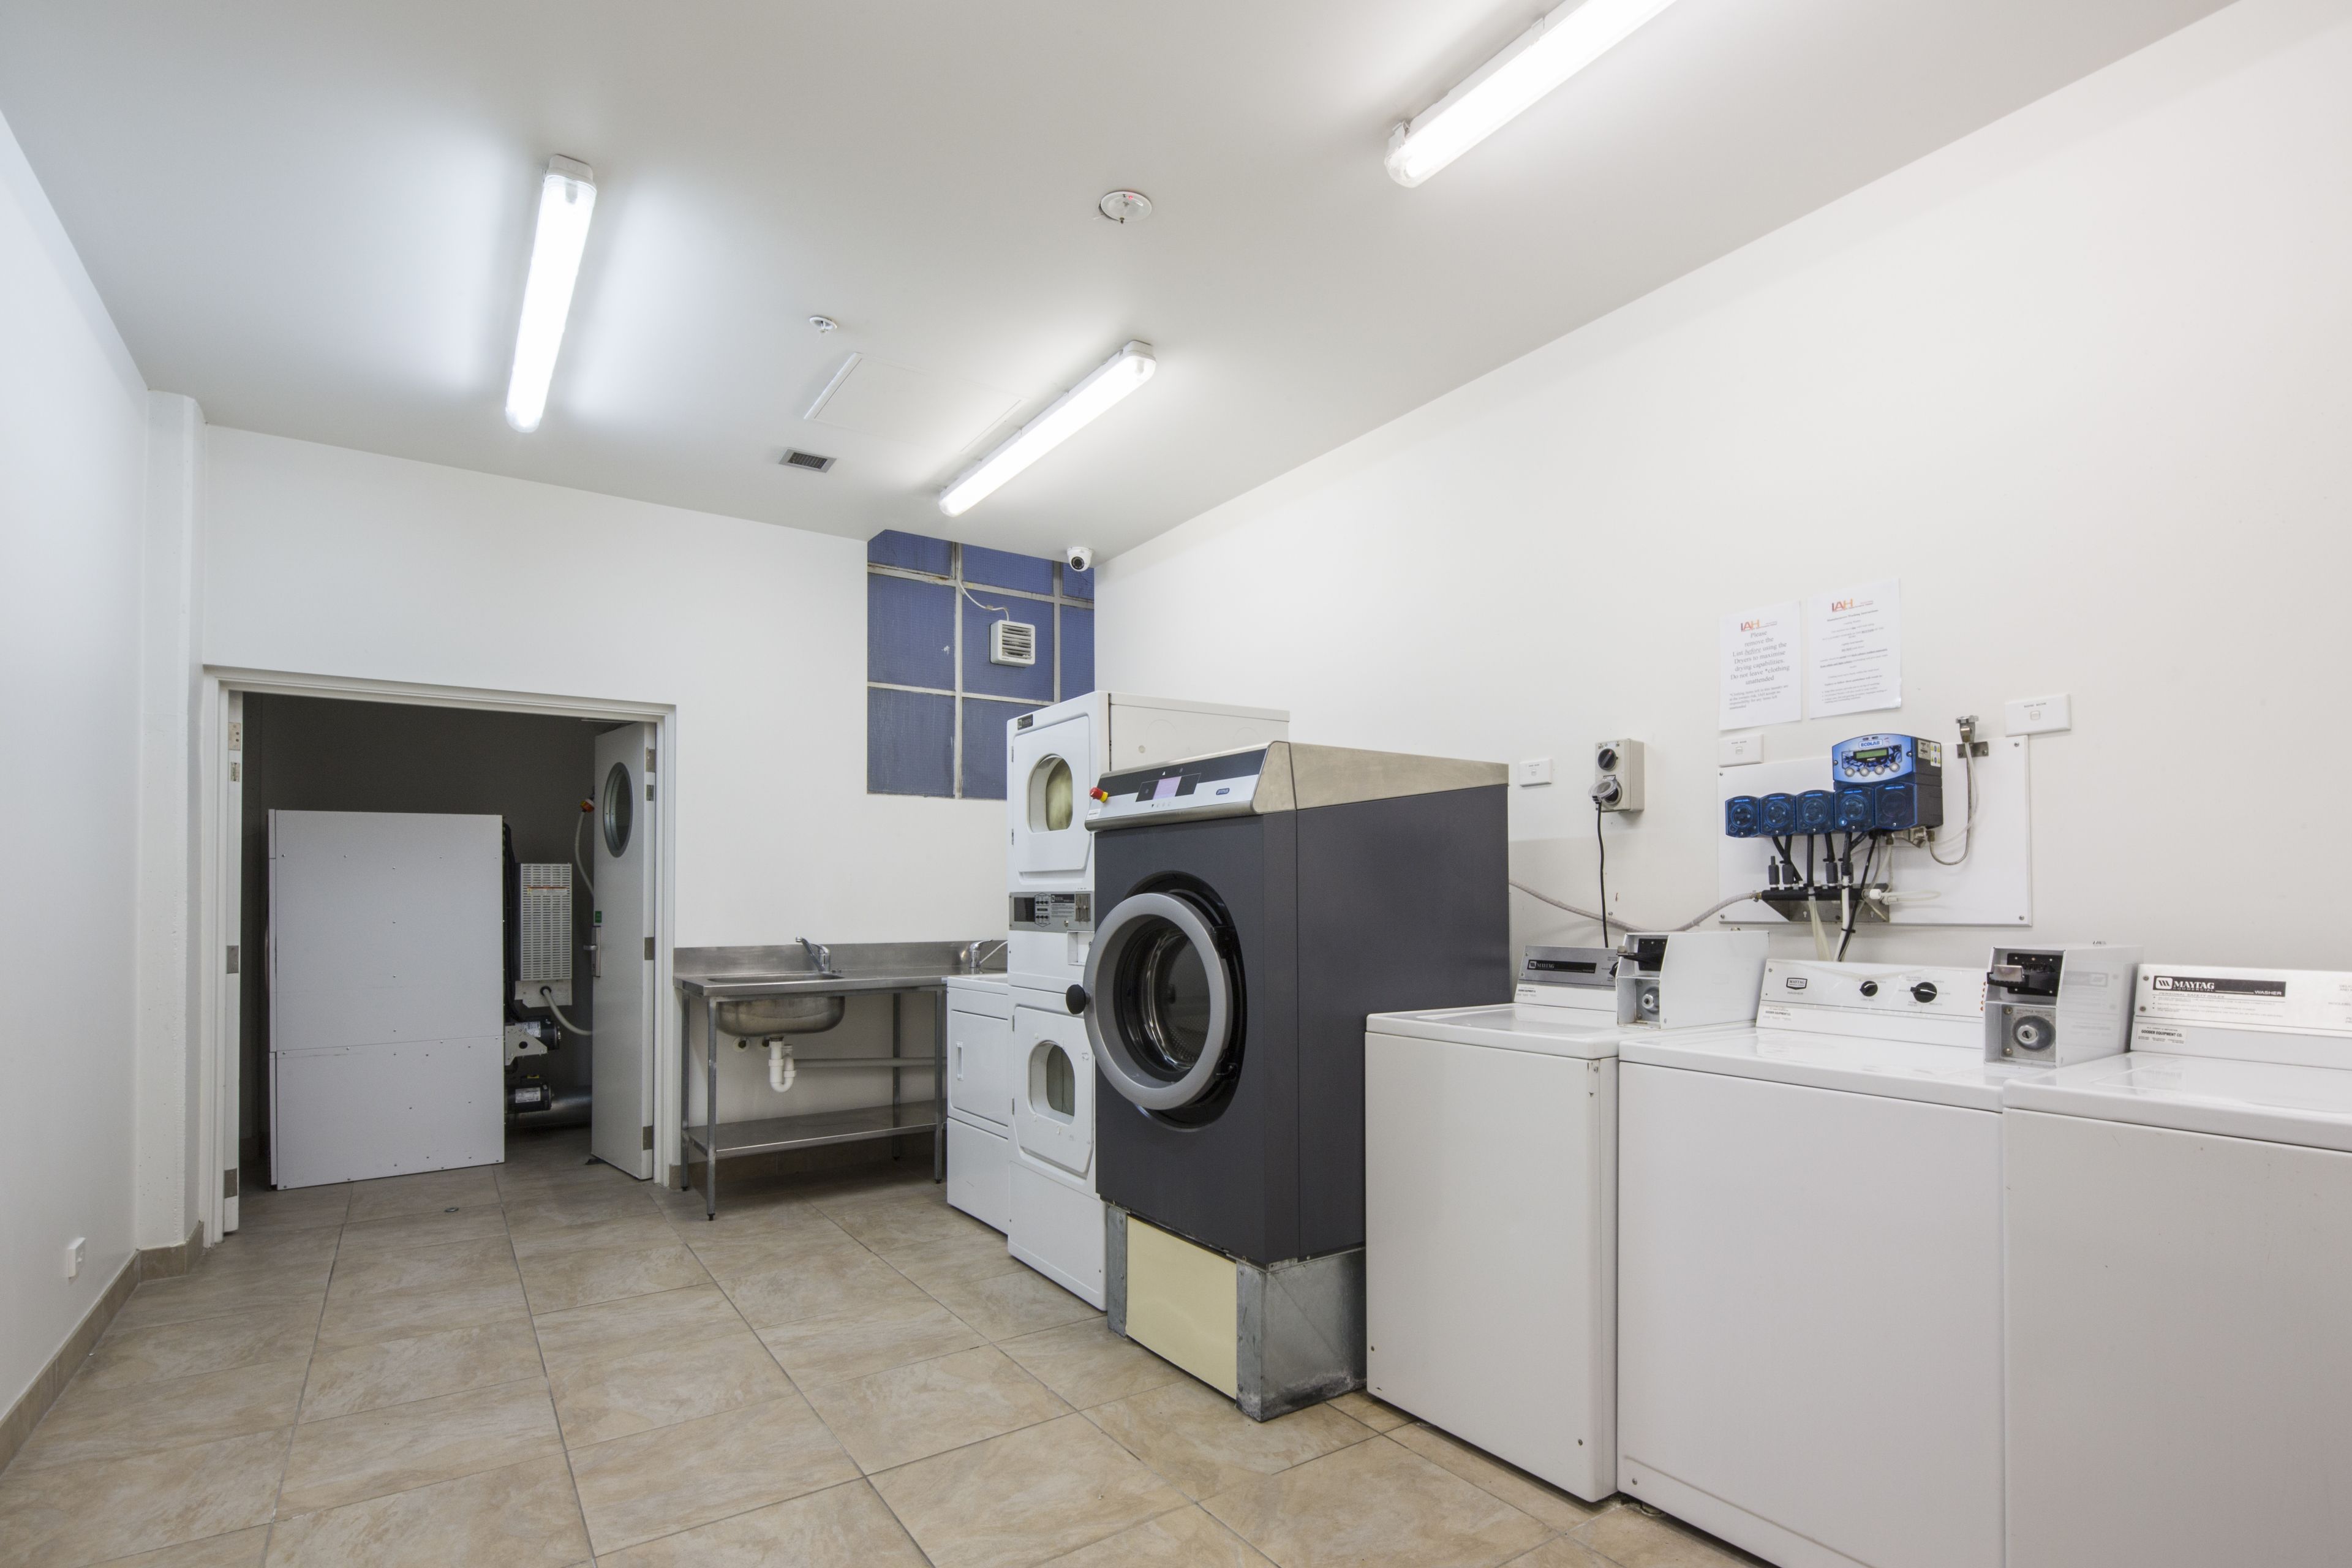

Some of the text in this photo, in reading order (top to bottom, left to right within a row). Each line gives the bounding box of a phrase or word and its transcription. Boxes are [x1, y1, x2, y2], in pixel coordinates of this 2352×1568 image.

[1832, 598, 1853, 612] IAH
[1740, 619, 1760, 631] IAH
[1744, 647, 1761, 656] before
[1760, 650, 1786, 659] maximise
[1753, 658, 1785, 668] capabilities.
[1745, 675, 1774, 685] unattended
[2173, 981, 2215, 990] MAYTAG
